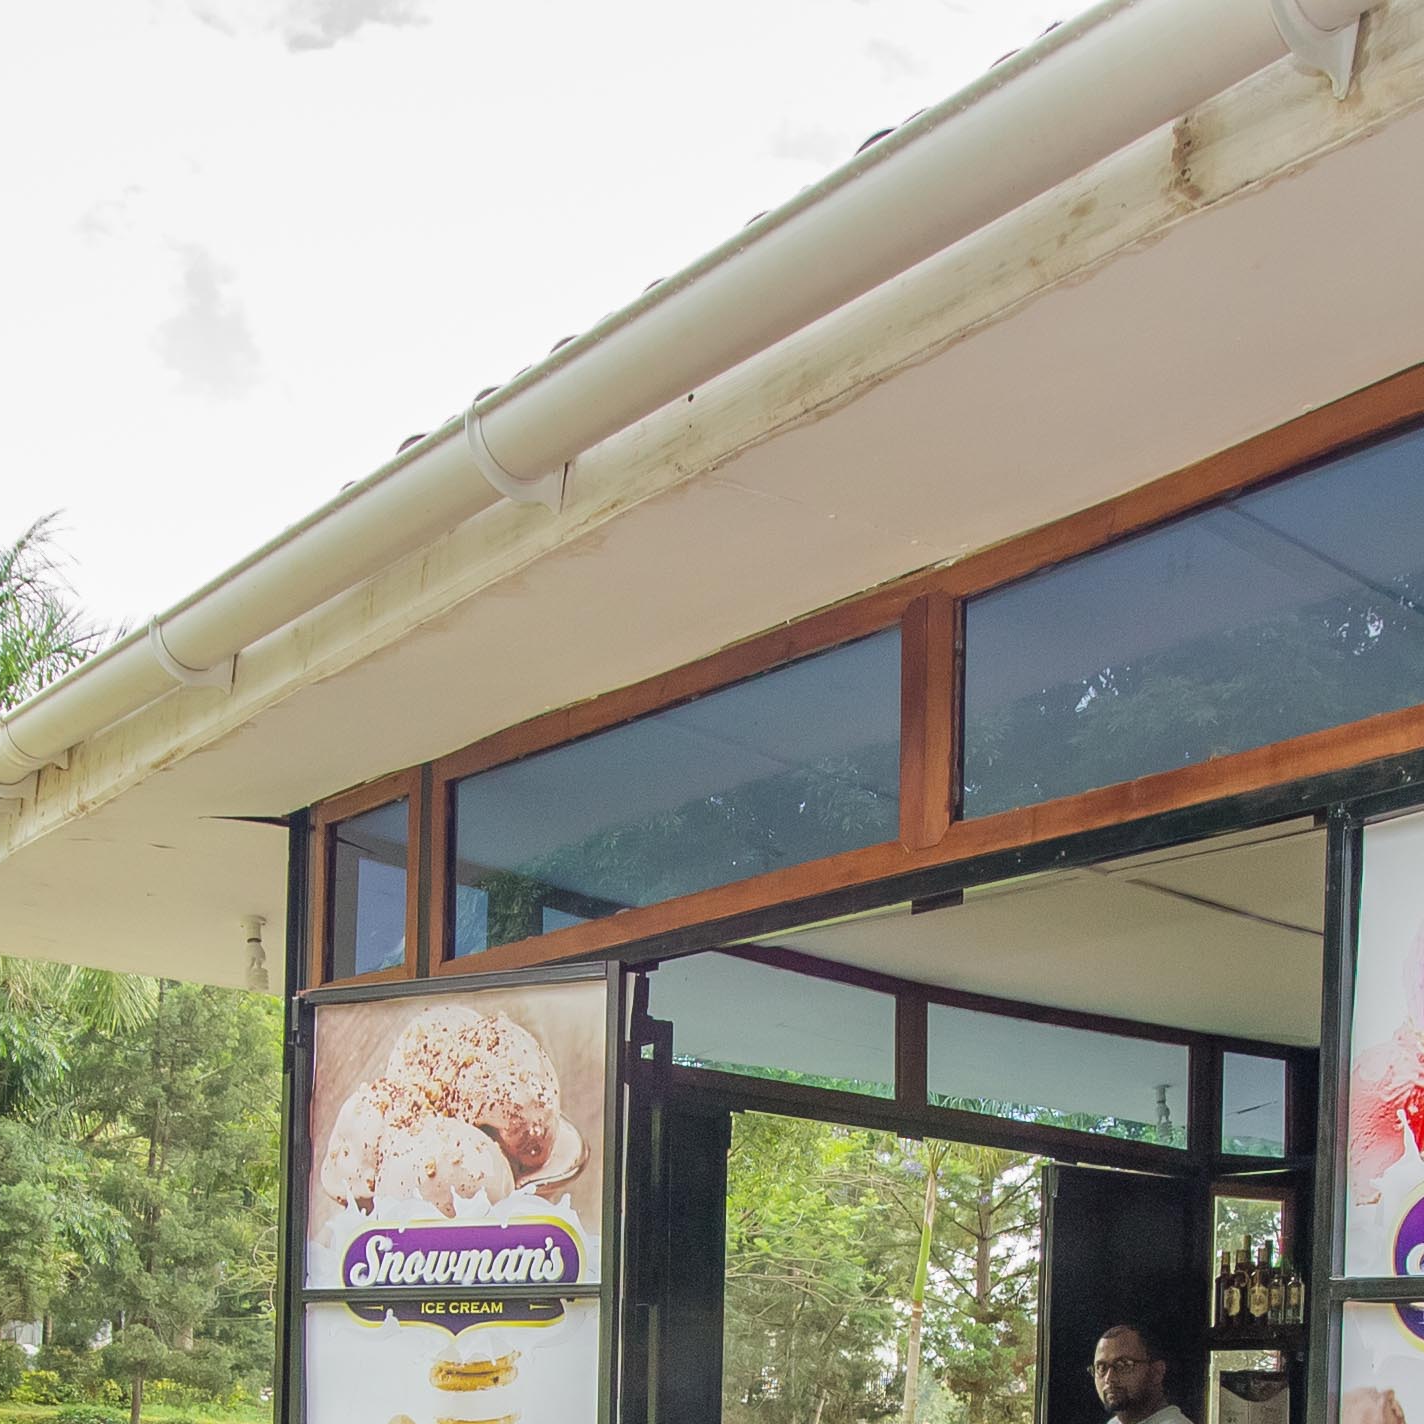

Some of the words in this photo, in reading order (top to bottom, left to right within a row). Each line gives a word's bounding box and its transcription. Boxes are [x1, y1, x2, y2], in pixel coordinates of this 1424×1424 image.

[349, 1235, 565, 1288] Snowman's
[420, 1302, 445, 1314] ICE
[449, 1302, 503, 1314] CREAM
